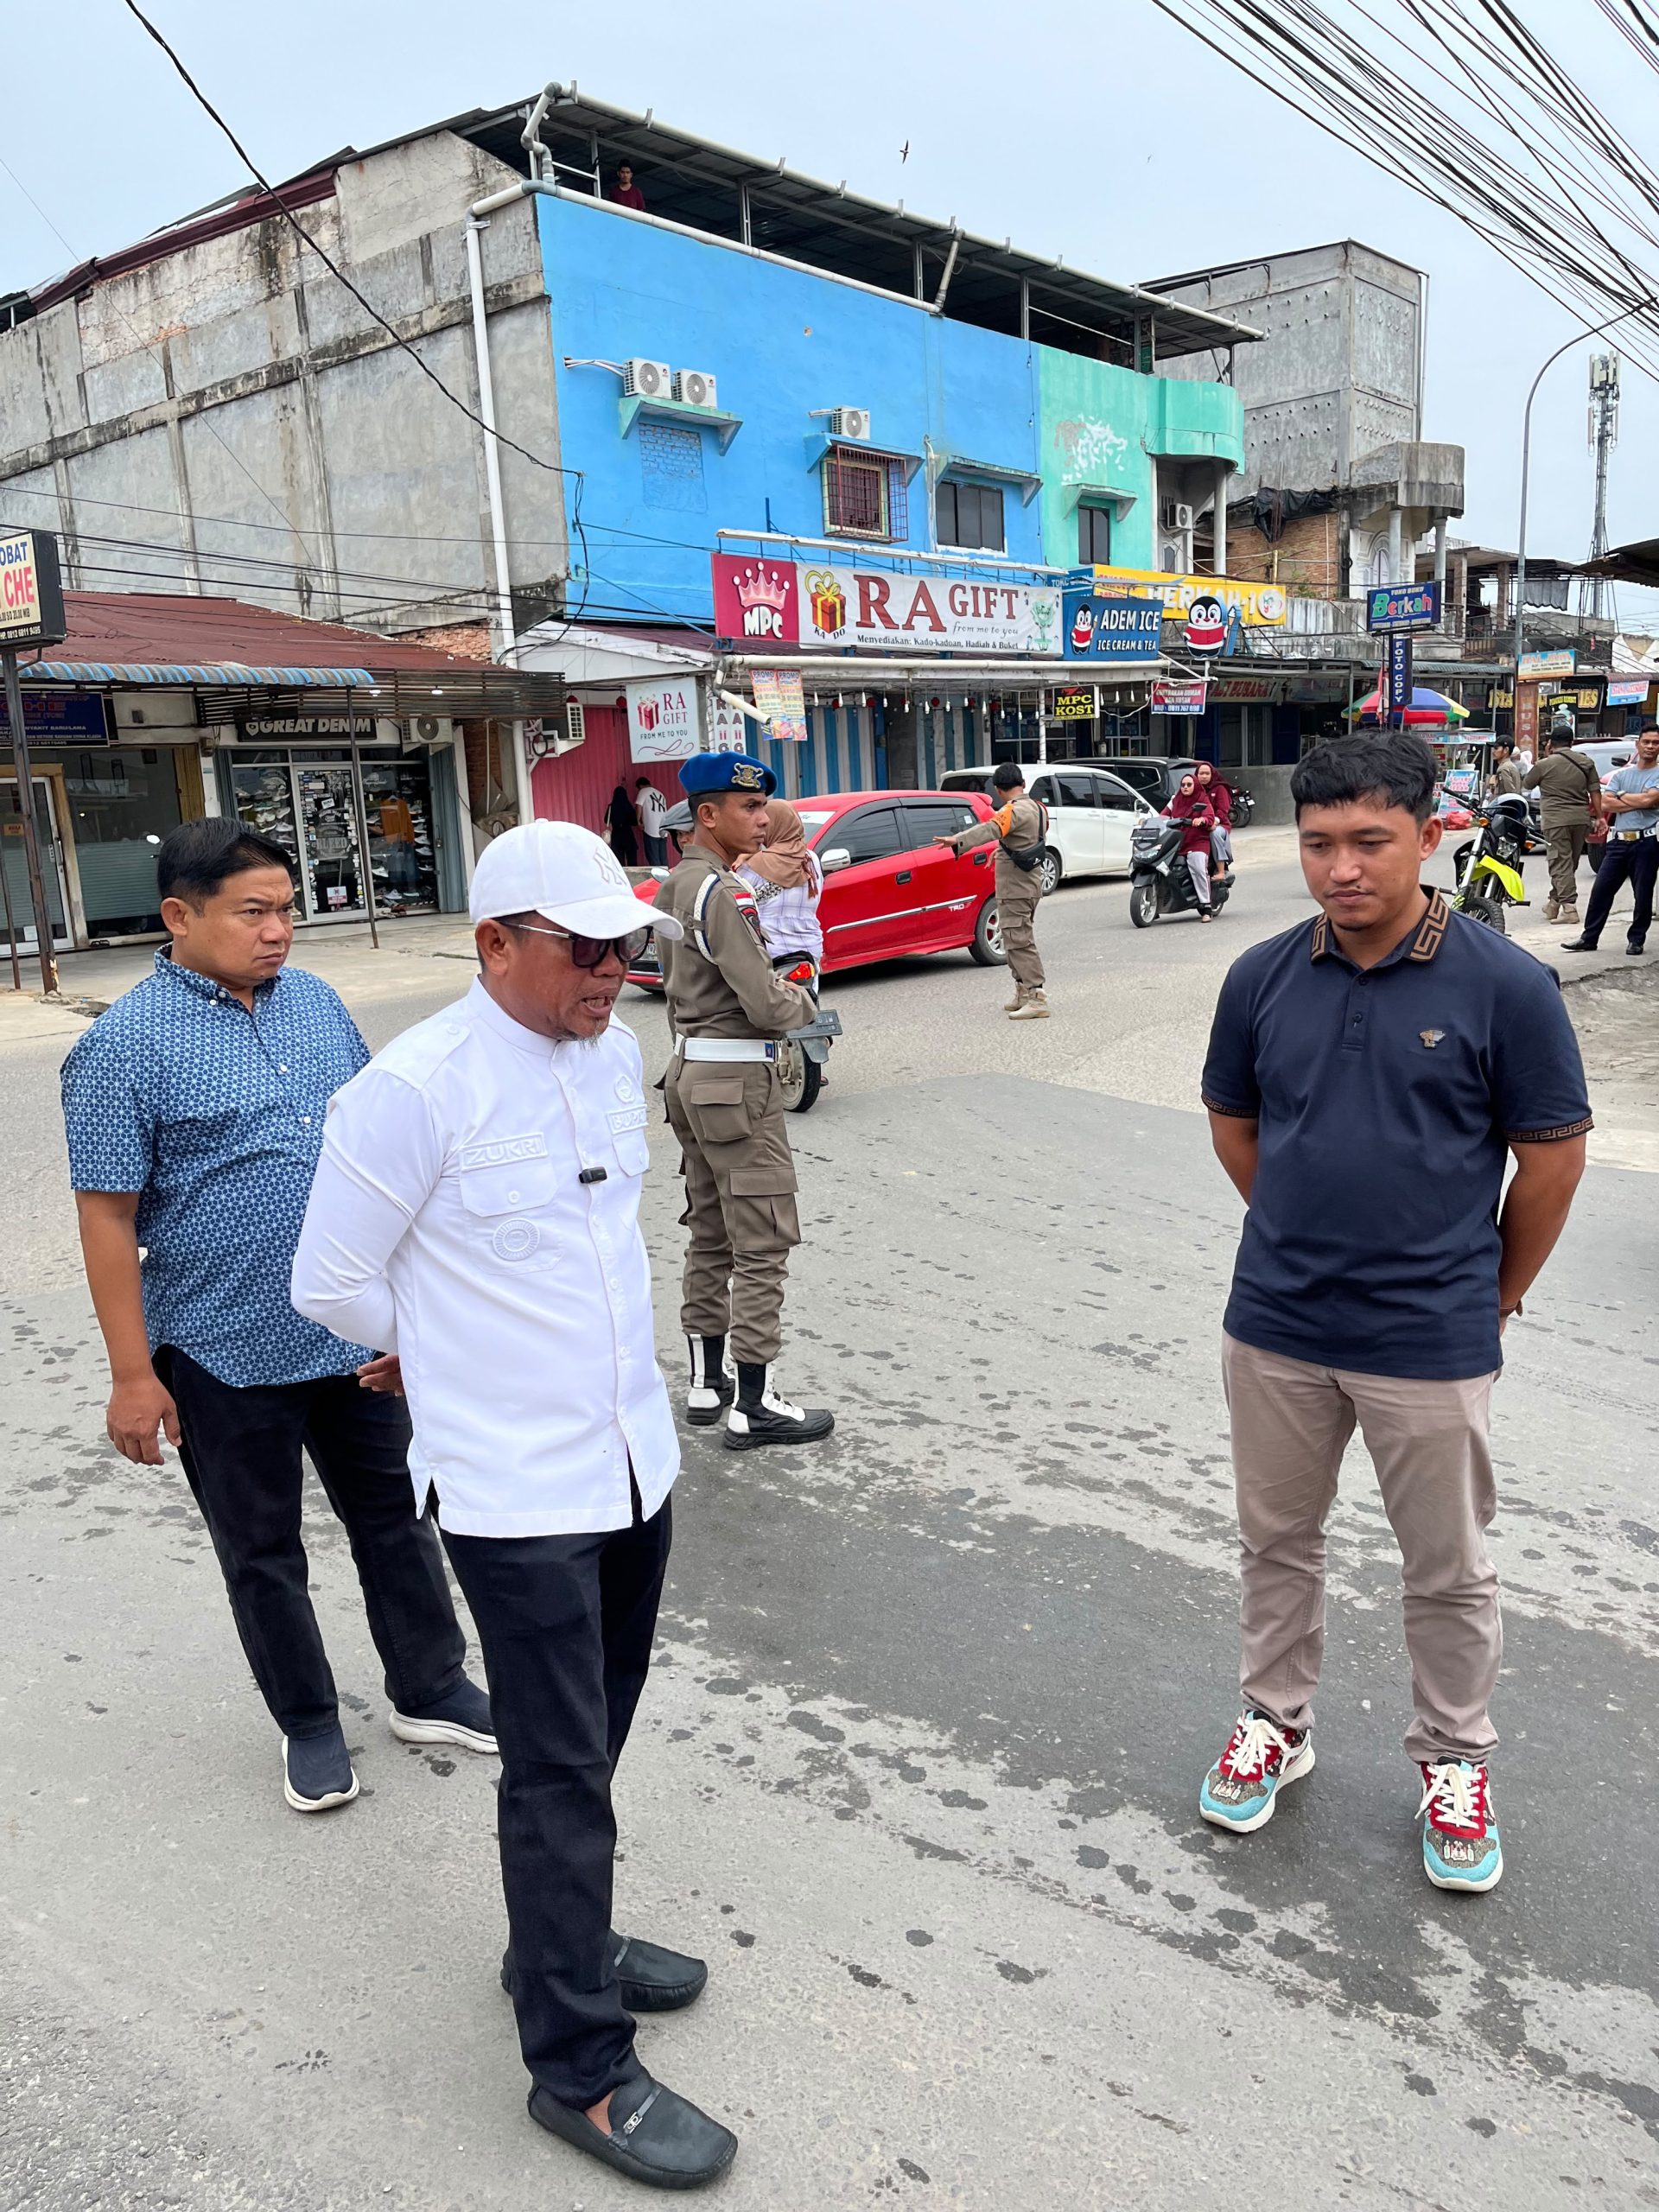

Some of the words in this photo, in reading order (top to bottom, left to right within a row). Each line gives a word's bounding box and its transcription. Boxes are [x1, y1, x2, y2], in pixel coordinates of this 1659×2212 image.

[3, 566, 35, 607] CHE
[853, 575, 948, 632] RA
[950, 583, 1020, 620] GIFT
[1372, 594, 1432, 618] Berkah
[743, 606, 784, 639] MPC
[952, 620, 975, 634] from
[1001, 628, 1019, 639] you
[1100, 609, 1135, 631] ADEM
[1139, 611, 1160, 632] ICE
[966, 639, 990, 648] Hadiah
[1097, 639, 1110, 651] ICE
[1112, 639, 1135, 651] CREAM
[1137, 640, 1142, 650] &
[1144, 639, 1156, 650] TEA
[1394, 641, 1403, 670] FOTO
[1394, 674, 1403, 702] COPY
[663, 692, 687, 710] RA
[1055, 704, 1094, 716] KOST
[1057, 695, 1092, 705] MPC
[259, 718, 315, 734] GREAT
[663, 712, 688, 725] GIFT
[467, 1137, 543, 1163] ZUKRI
